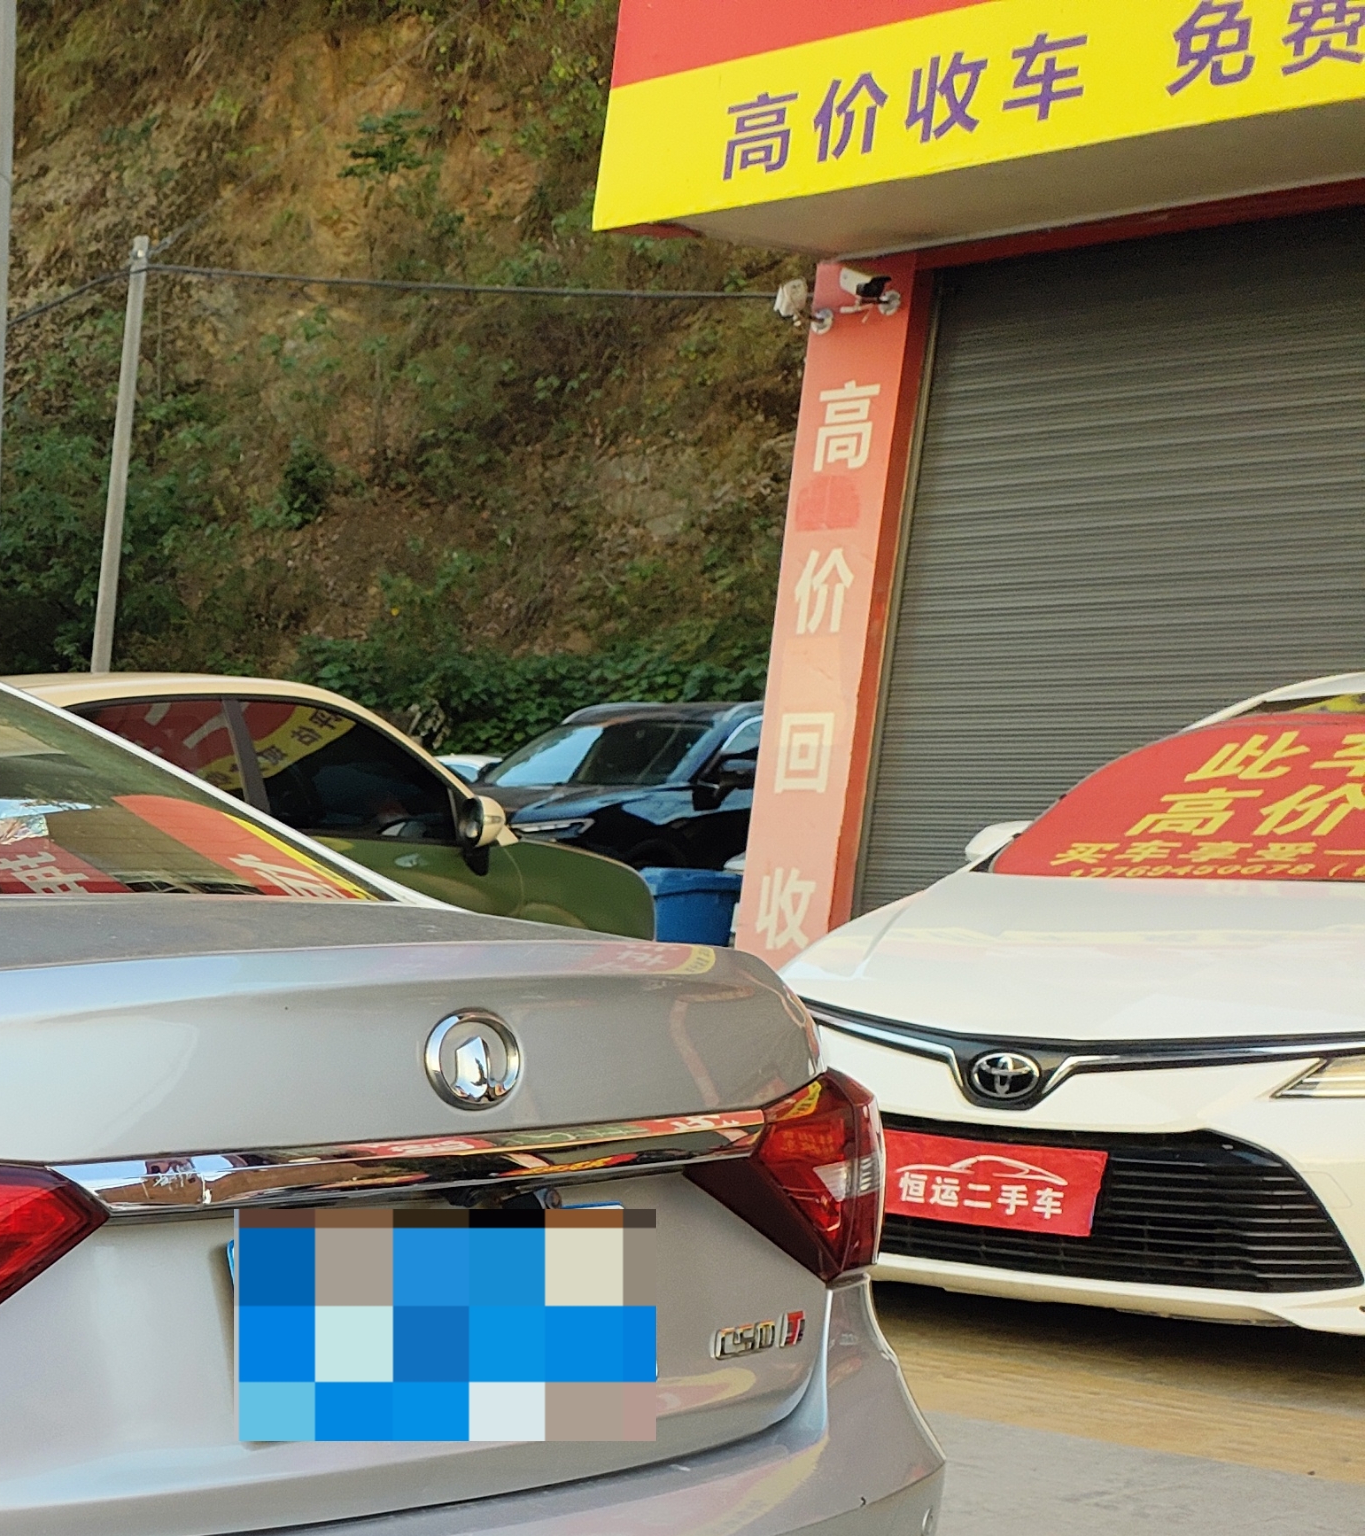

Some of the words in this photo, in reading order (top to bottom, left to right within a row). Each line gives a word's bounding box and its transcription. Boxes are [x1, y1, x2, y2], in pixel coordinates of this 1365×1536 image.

[722, 33, 1088, 181] 高价收车
[1166, 0, 1365, 97] 免费
[756, 380, 881, 950] 高价回收
[1124, 782, 1365, 837] 高价
[898, 1171, 1065, 1219] 恒运二手车
